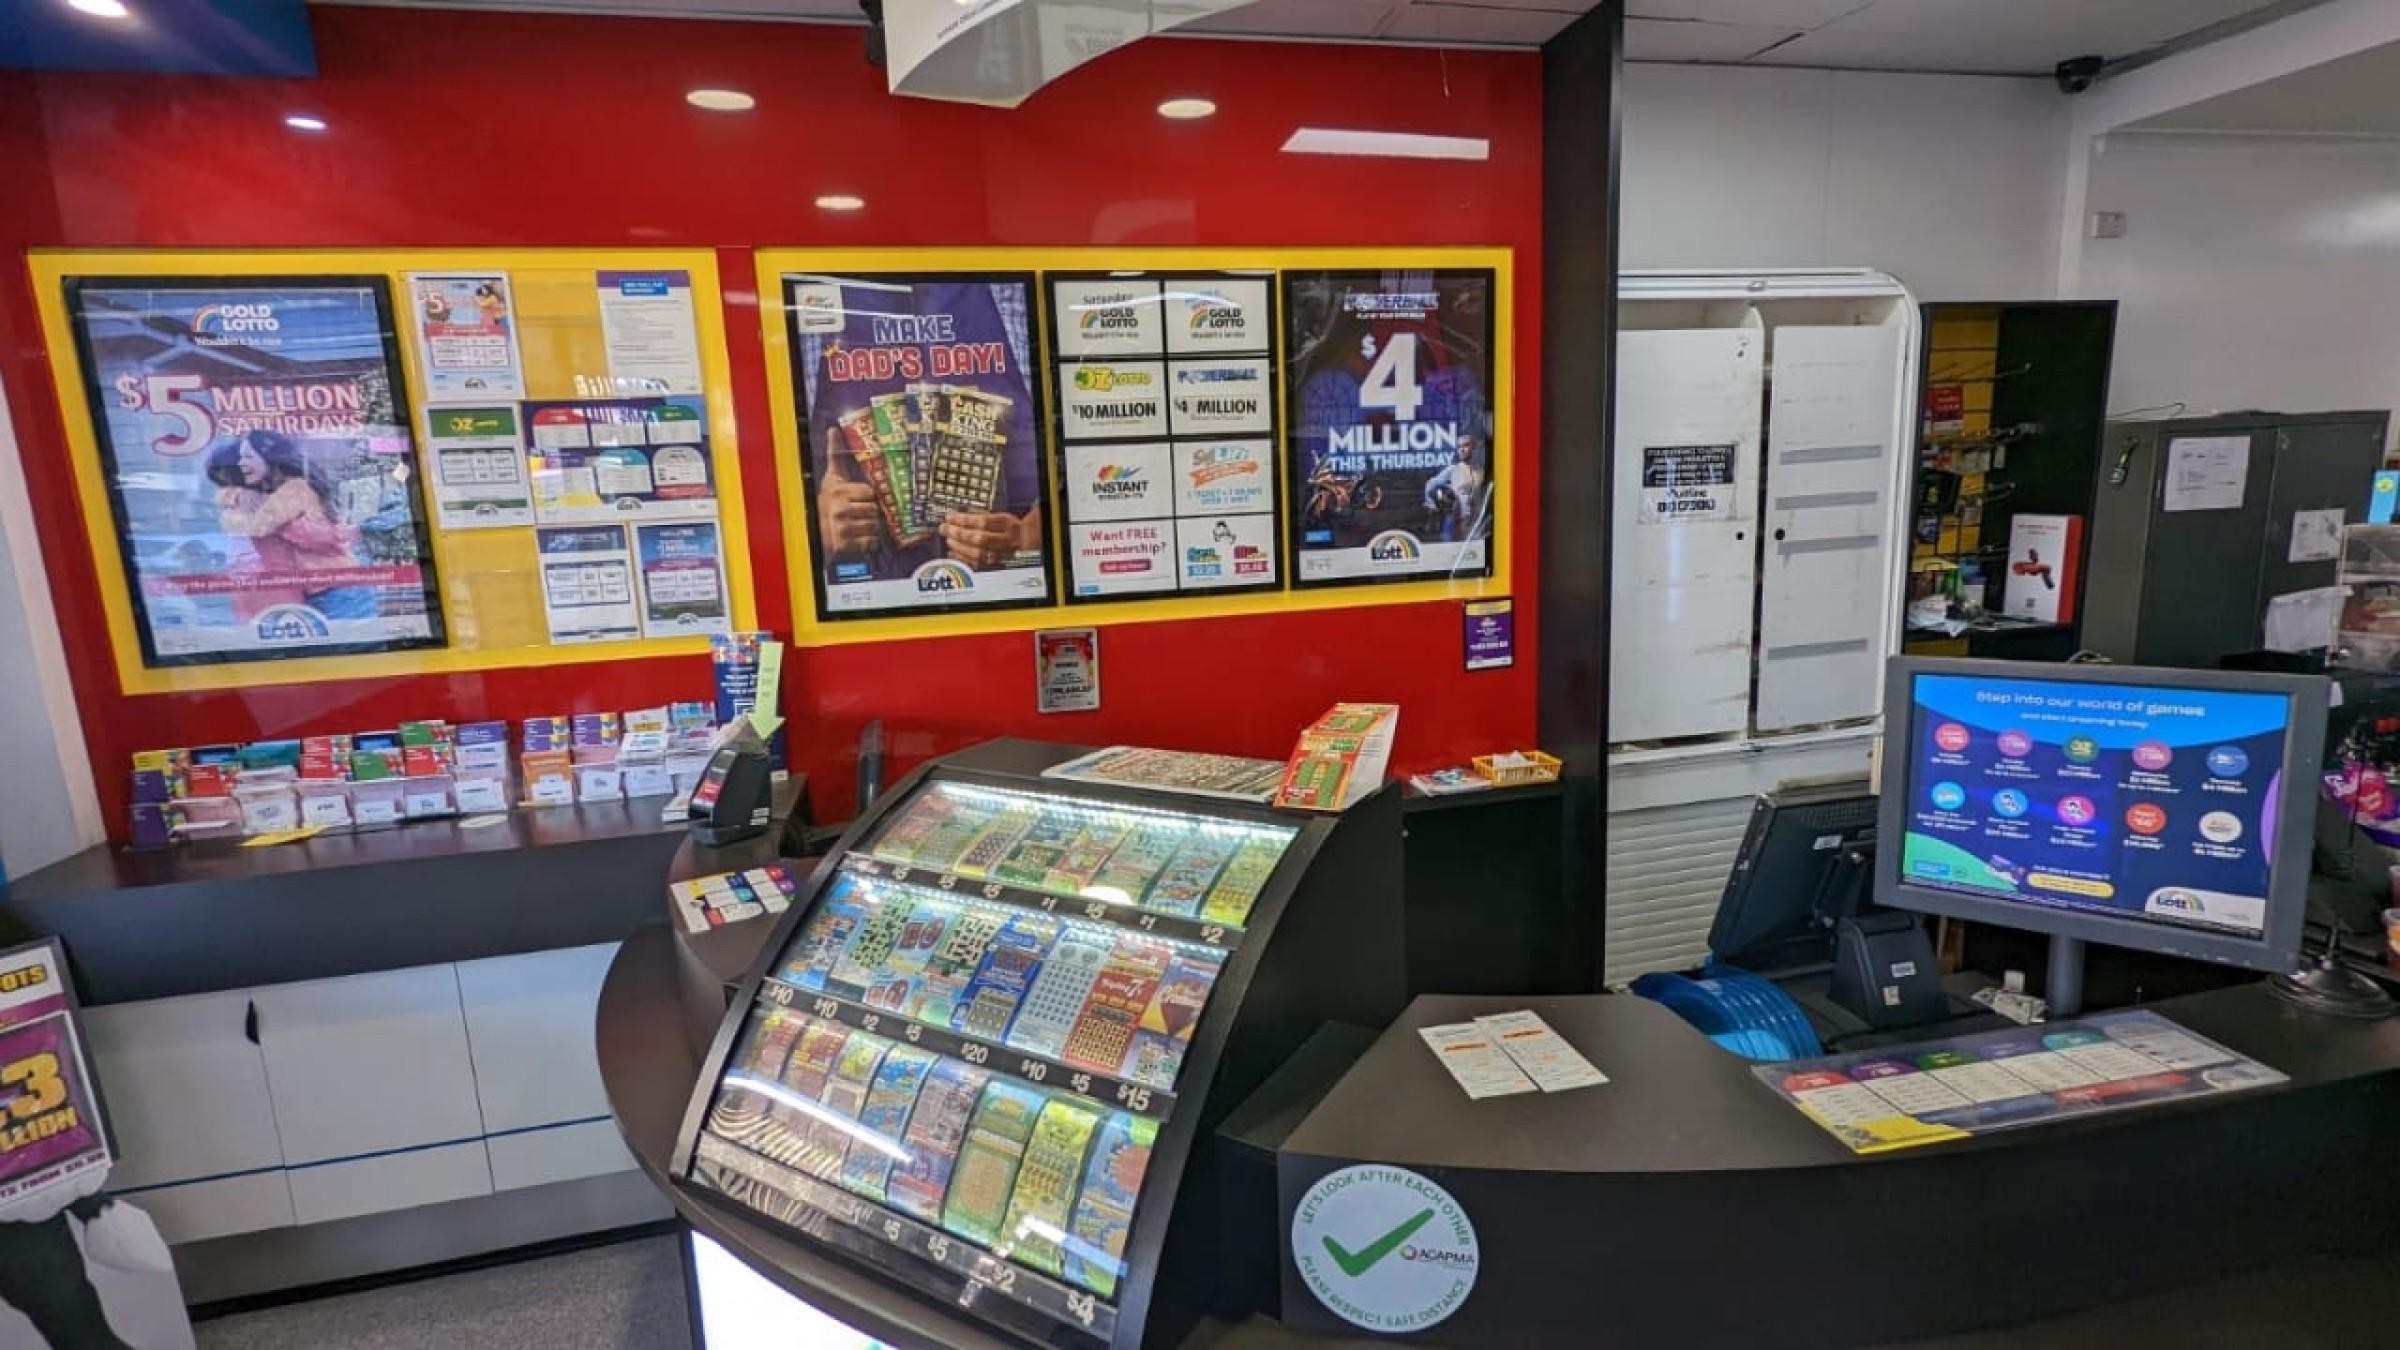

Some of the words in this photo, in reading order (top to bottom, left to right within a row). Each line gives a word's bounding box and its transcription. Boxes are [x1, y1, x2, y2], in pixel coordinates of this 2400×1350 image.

[220, 304, 271, 318] GOLD
[1099, 307, 1135, 319] GOLD
[1208, 307, 1241, 318] GOLD
[222, 318, 280, 332] LOTTO
[872, 314, 956, 345] MAKE
[1100, 318, 1139, 328] LOTTO
[1209, 318, 1245, 328] LOTTO
[829, 346, 924, 381] DAD'S
[929, 342, 1006, 378] DAY!
[1359, 333, 1423, 421] $4
[211, 383, 361, 412] MILLION
[1197, 399, 1257, 415] MILLION
[115, 372, 215, 456] $5
[1072, 402, 1094, 420] $10
[1095, 402, 1157, 418] MILLION
[218, 412, 364, 437] SATURDAYS
[1328, 421, 1458, 453] MILLION
[1328, 454, 1366, 471] THIS
[1372, 451, 1456, 470] THURSDAY
[1093, 480, 1149, 494] INSTANT
[1089, 531, 1123, 541] Want
[1126, 527, 1158, 539] FREE
[1082, 542, 1167, 556] membership?
[1976, 690, 2011, 705] Step
[2014, 693, 2045, 706] into
[2046, 697, 2072, 707] our
[2077, 697, 2123, 712] world
[2126, 701, 2144, 712] of
[2145, 704, 2206, 718] games
[1200, 926, 1225, 944] $2
[813, 997, 839, 1020] $10
[862, 1012, 880, 1033] $2
[961, 1042, 989, 1064] $20
[1021, 1059, 1047, 1081] $10
[1070, 1072, 1092, 1093] $5
[1116, 1083, 1151, 1111] $15
[1302, 1195, 1323, 1225] LET'S
[1320, 1173, 1354, 1200] LOOK
[1359, 1170, 1402, 1184] AFTER
[1405, 1175, 1444, 1206] EACH
[1441, 1202, 1472, 1247] OTHER
[1418, 1248, 1475, 1264] ACAPMA
[1301, 1254, 1332, 1296] PLEASE
[1329, 1293, 1382, 1325] RESPECT
[1386, 1314, 1418, 1328] SAFE
[1417, 1277, 1468, 1324] DISTANCE
[1067, 1290, 1096, 1326] $4
